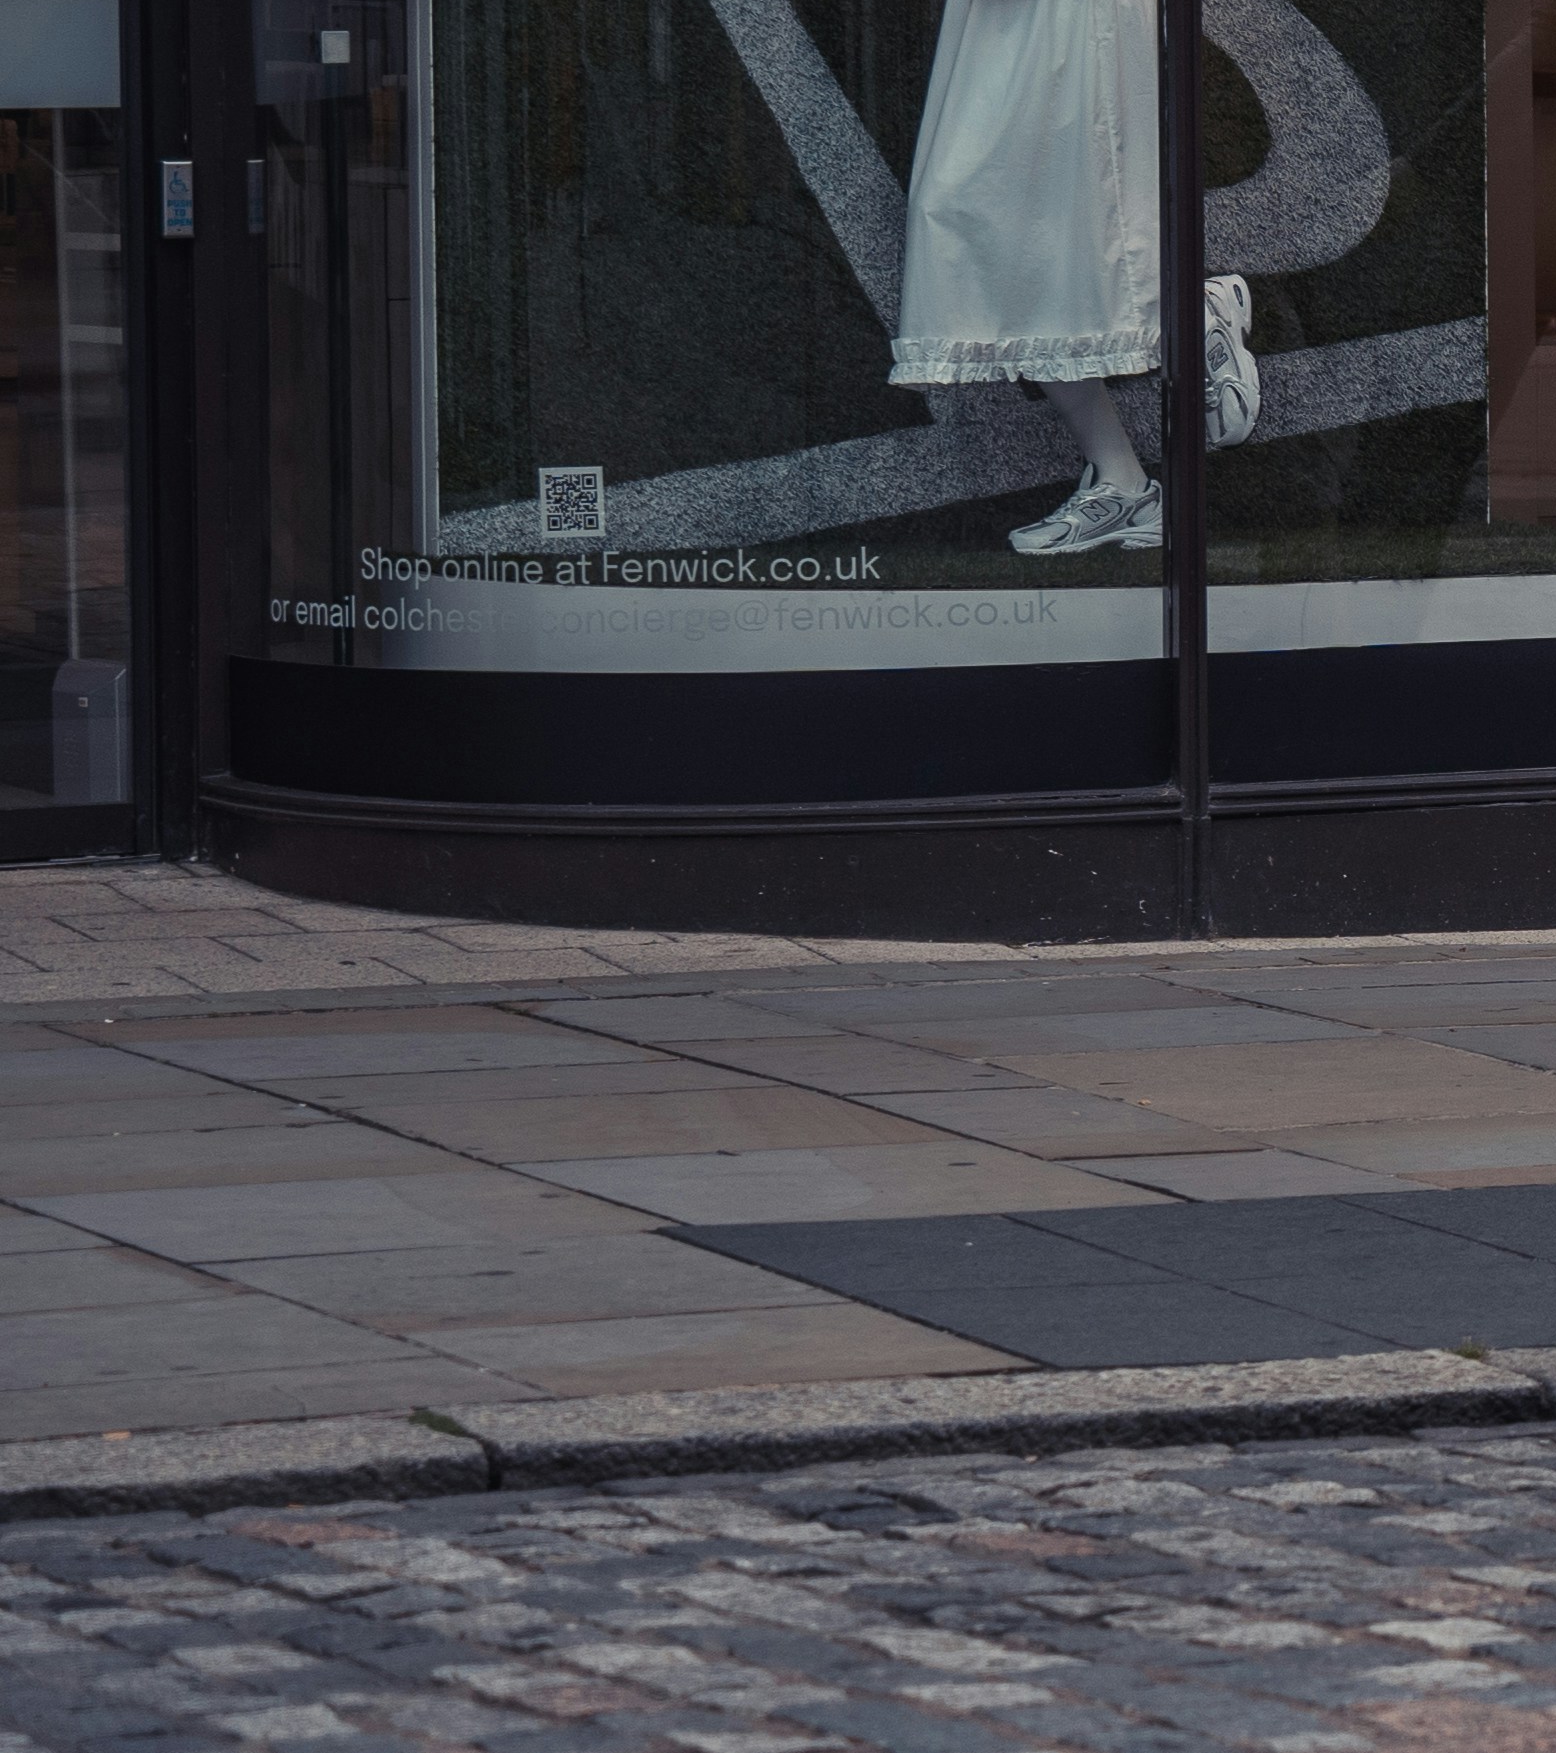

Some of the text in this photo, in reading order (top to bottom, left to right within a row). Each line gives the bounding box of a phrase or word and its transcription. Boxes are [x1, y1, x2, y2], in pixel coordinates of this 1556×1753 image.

[167, 199, 193, 208] PUSH
[174, 209, 186, 217] TO
[167, 218, 193, 227] OPEN
[361, 546, 881, 590] Shop online at Fenwick.co.uk
[271, 593, 1058, 641] or email colchesteconcierge@fenwick.co.uk
